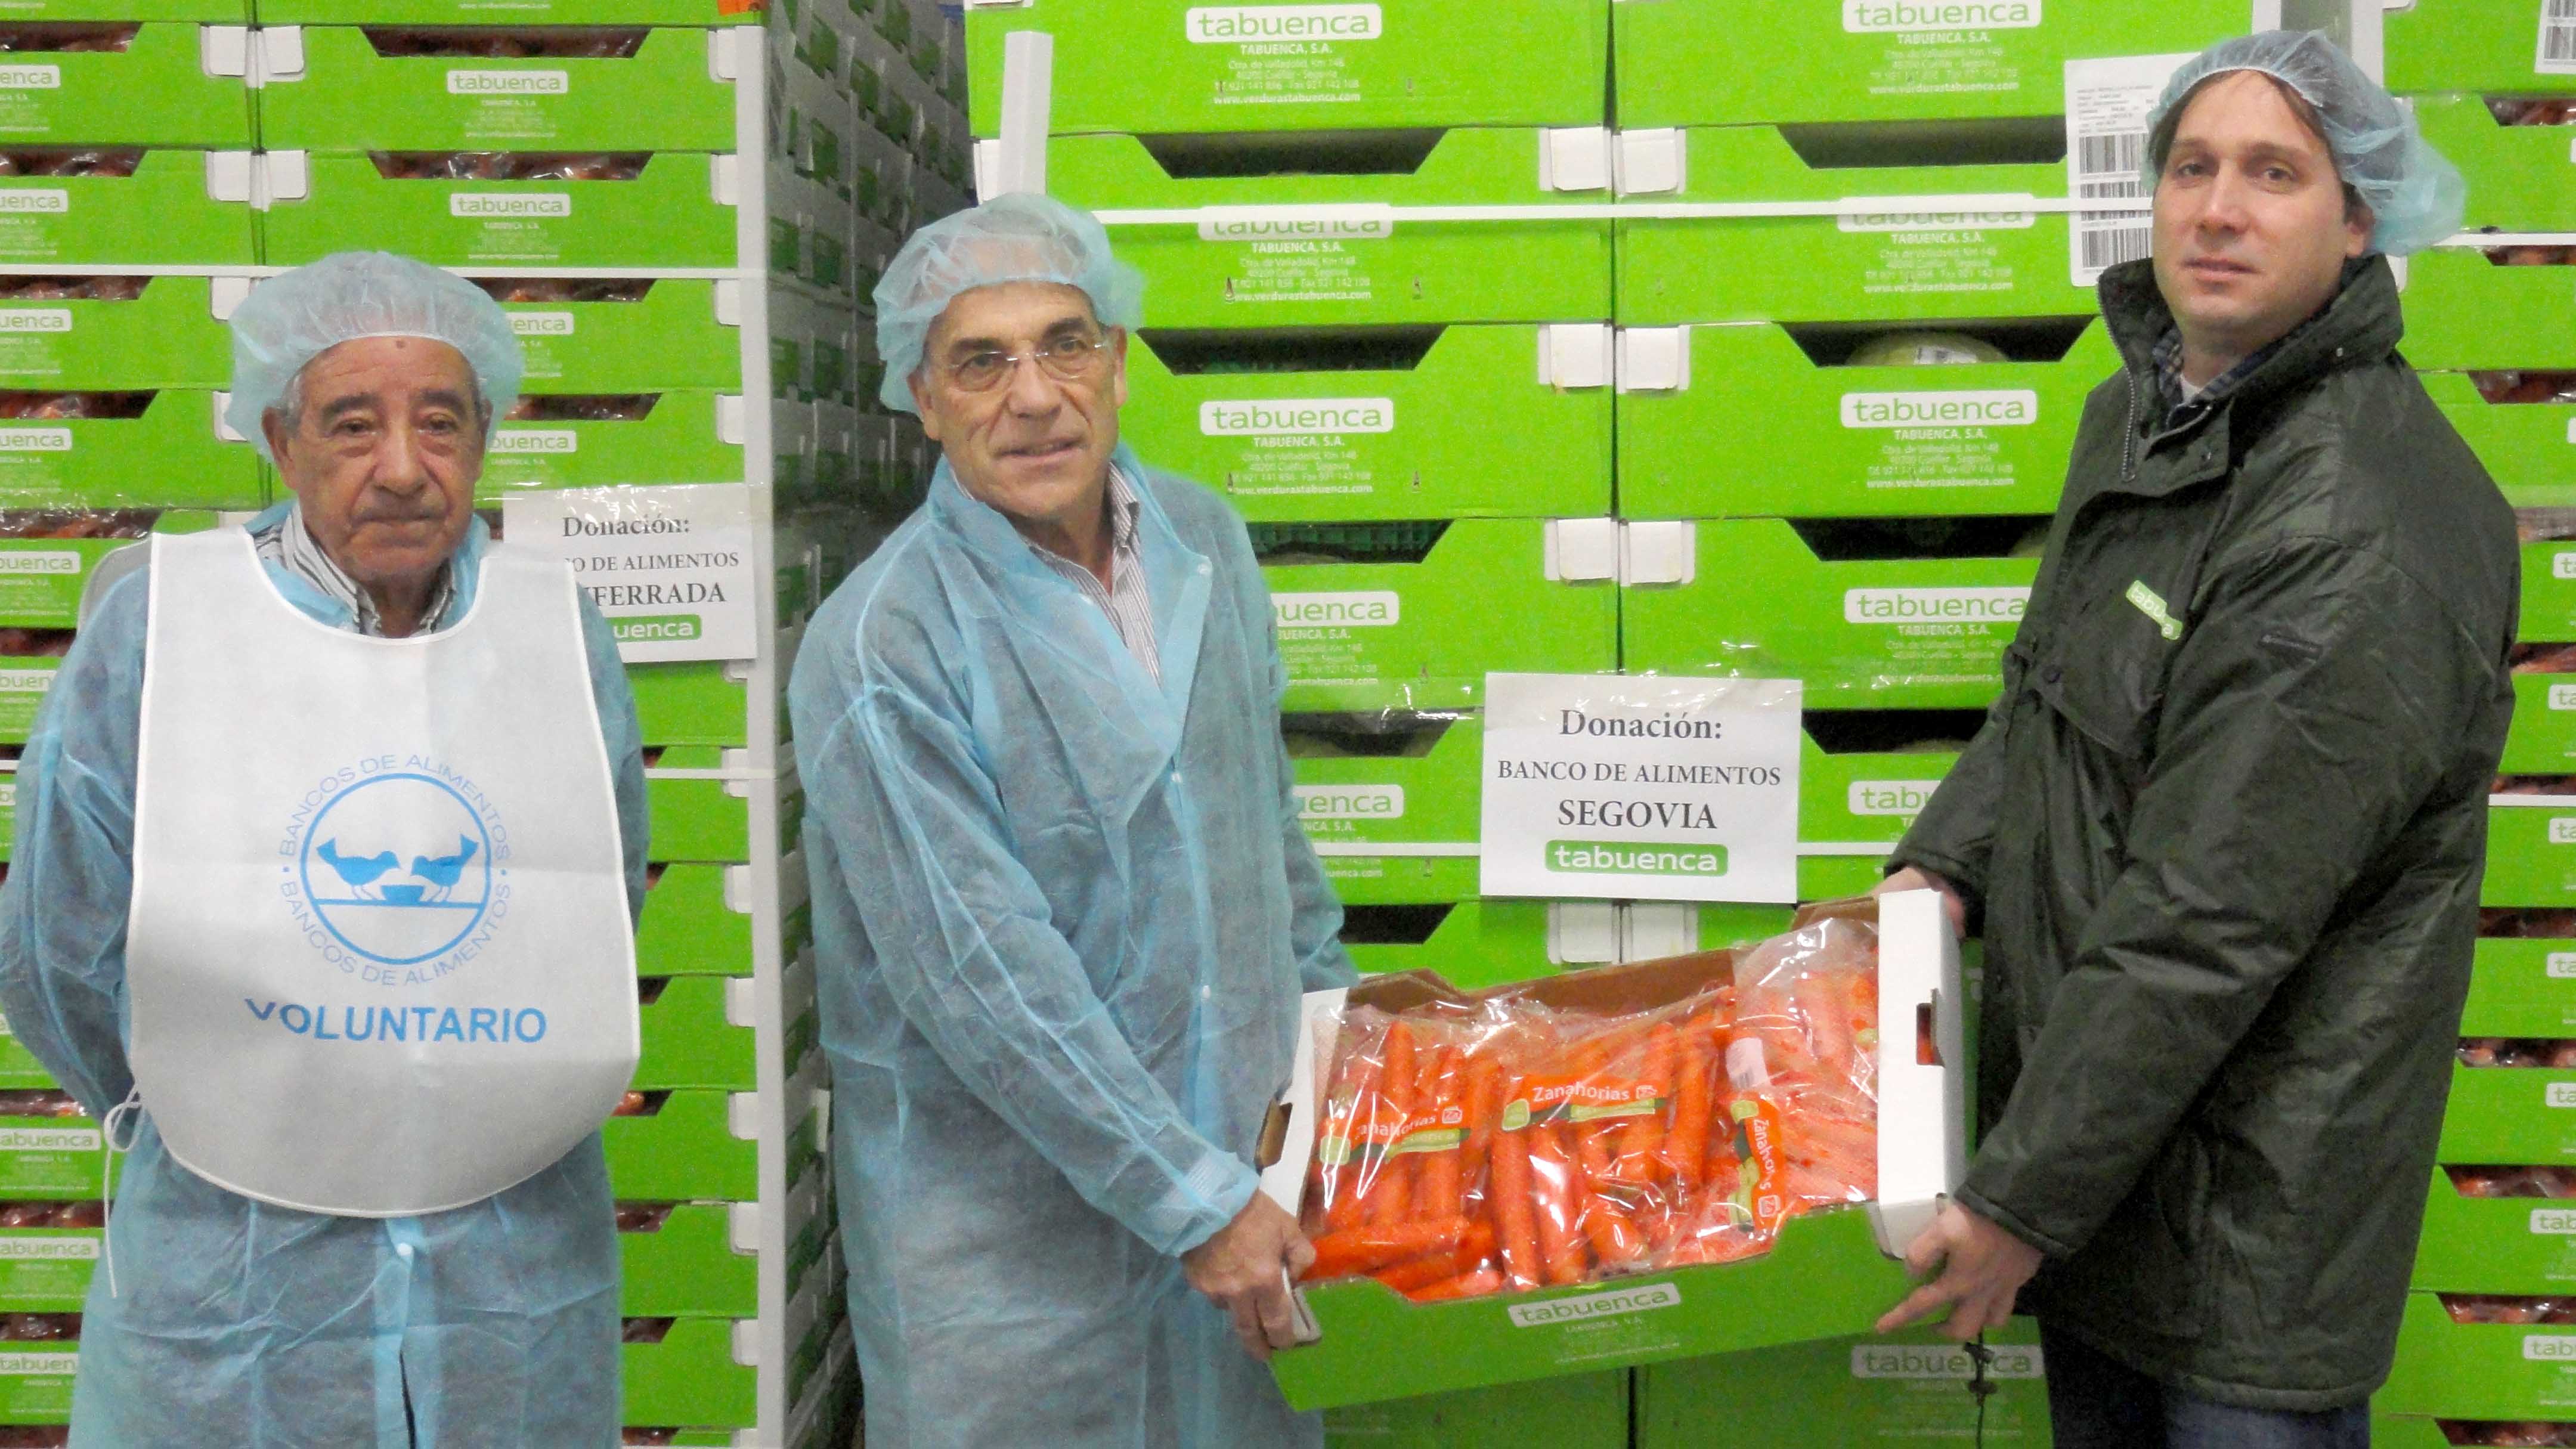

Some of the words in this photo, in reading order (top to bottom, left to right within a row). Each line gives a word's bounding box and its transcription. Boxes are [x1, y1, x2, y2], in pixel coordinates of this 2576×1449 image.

[1198, 13, 1370, 37] tabuenca
[1855, 1, 2030, 26] tabuenca
[455, 75, 561, 90] tabuenca
[458, 197, 563, 213] tabuenca
[1230, 290, 1371, 302] ww.verdurastabuenca.com
[512, 318, 566, 331] enca
[1212, 405, 1383, 430] tabuenca
[1853, 398, 2025, 422] tabuenca
[563, 513, 690, 537] Donación:
[592, 557, 618, 572] DE
[624, 552, 739, 571] ALIMENTOS
[1281, 601, 1388, 621] uenca
[1857, 594, 2027, 618] tabuenca
[614, 620, 694, 639] uenca
[1559, 708, 1722, 739] Donación:
[1497, 760, 1587, 781] BANCO
[1594, 763, 1627, 782] DE
[1634, 764, 1781, 786] ALIMENTOS
[280, 766, 357, 857] BANCOS
[360, 754, 398, 774] DE
[405, 754, 512, 860] ALIMENTOS
[1558, 798, 1717, 829] SEGOVIA
[1554, 845, 1717, 872] tabuenca
[280, 880, 357, 974] BANCOS
[362, 964, 398, 986] DE
[404, 883, 511, 986] ALIMENTOS
[244, 998, 547, 1044] VOLUNTARIO
[1532, 1081, 1630, 1102] Zanahorias
[1753, 1119, 1776, 1191] Zanahors
[1518, 1290, 1670, 1322] tabuenca
[1862, 1350, 2031, 1373] tabueca
